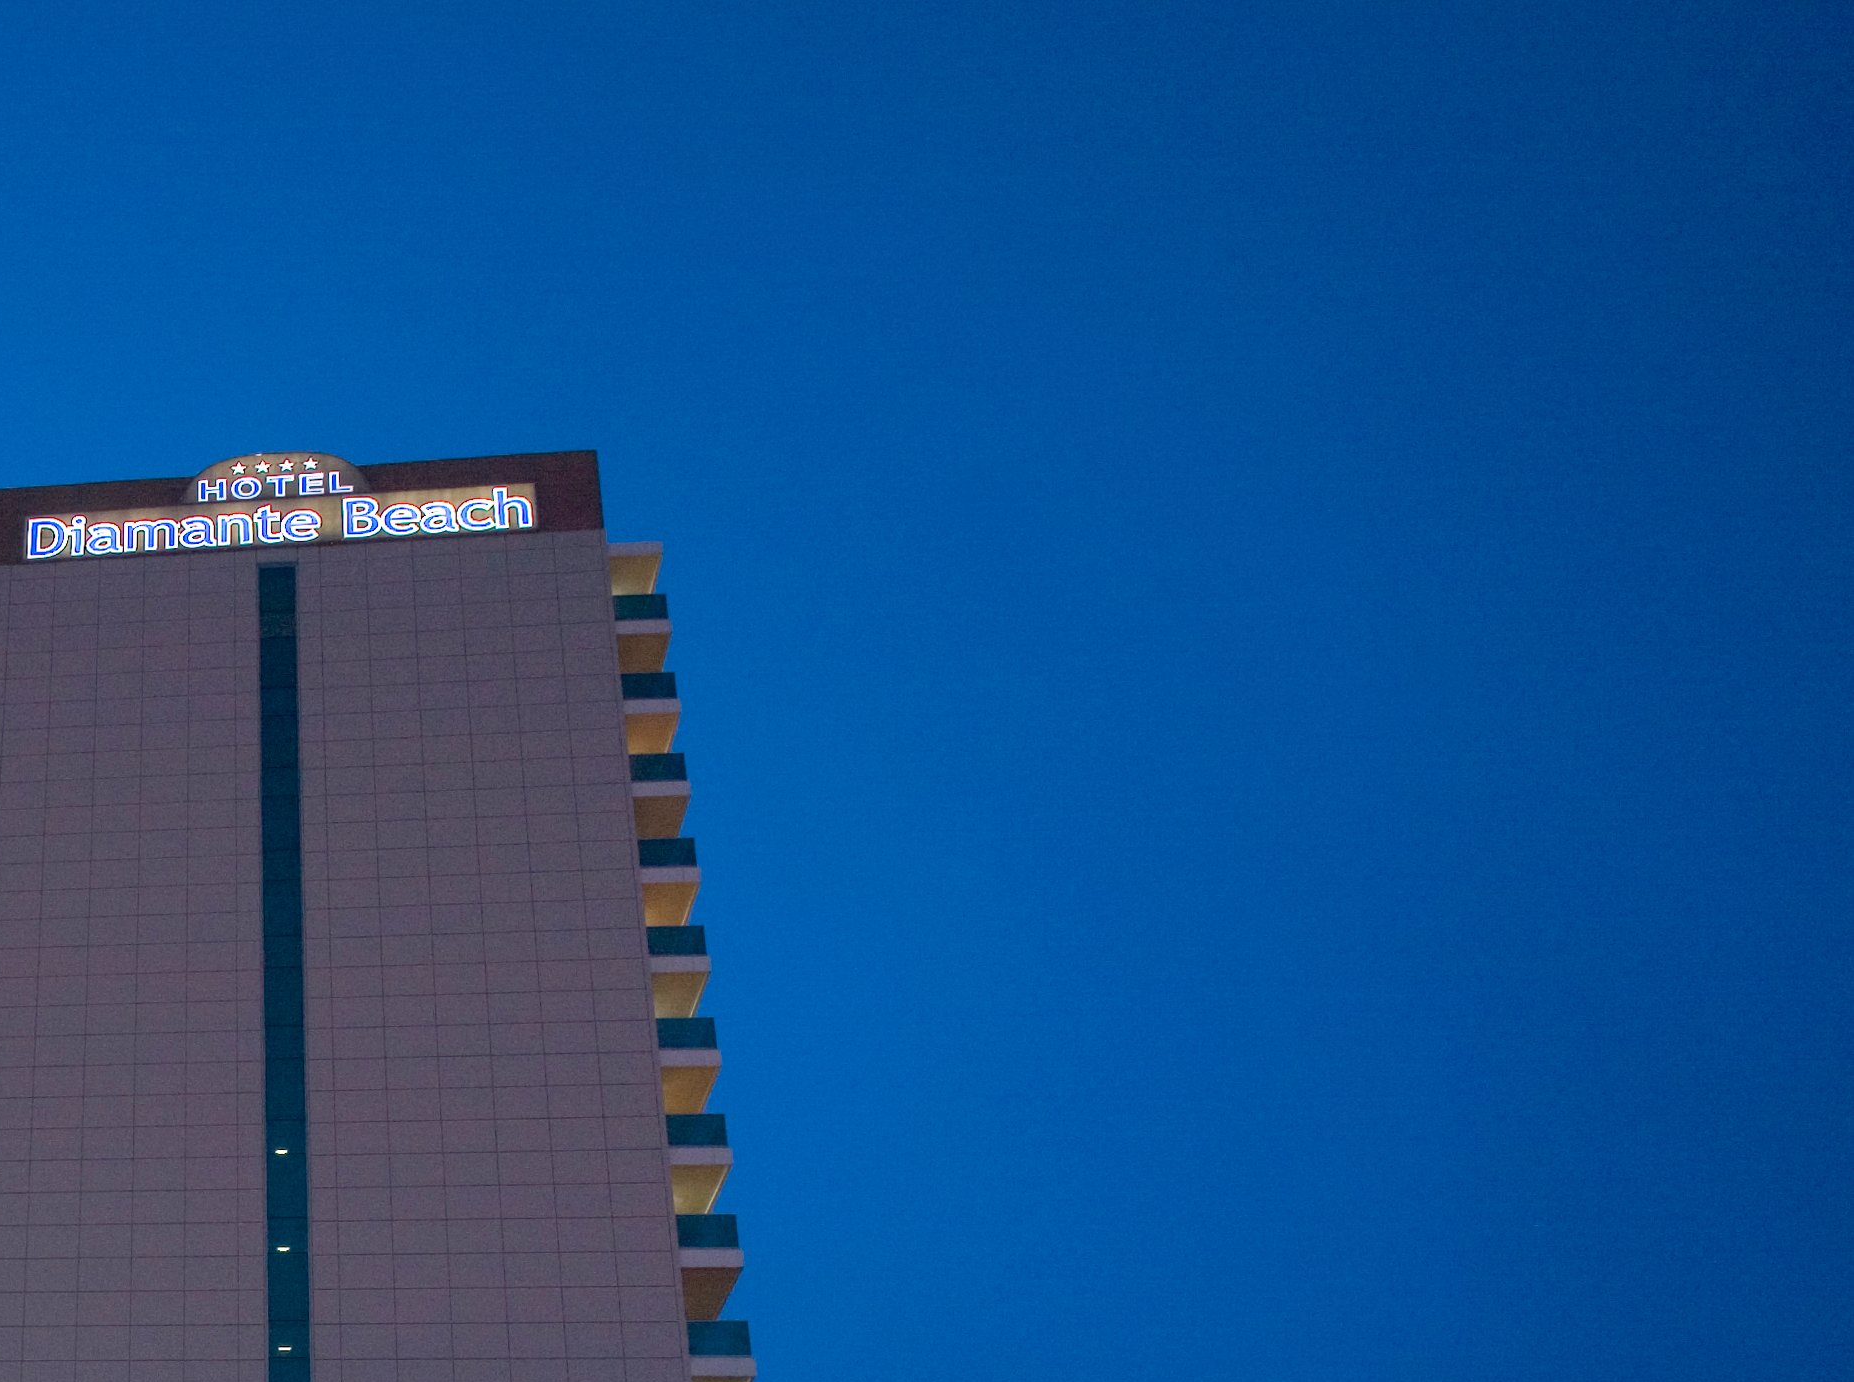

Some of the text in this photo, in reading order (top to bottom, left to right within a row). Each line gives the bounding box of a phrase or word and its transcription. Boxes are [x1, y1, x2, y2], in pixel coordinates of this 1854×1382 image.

[197, 470, 354, 502] HOTEL
[26, 485, 534, 560] Diamante Beach
